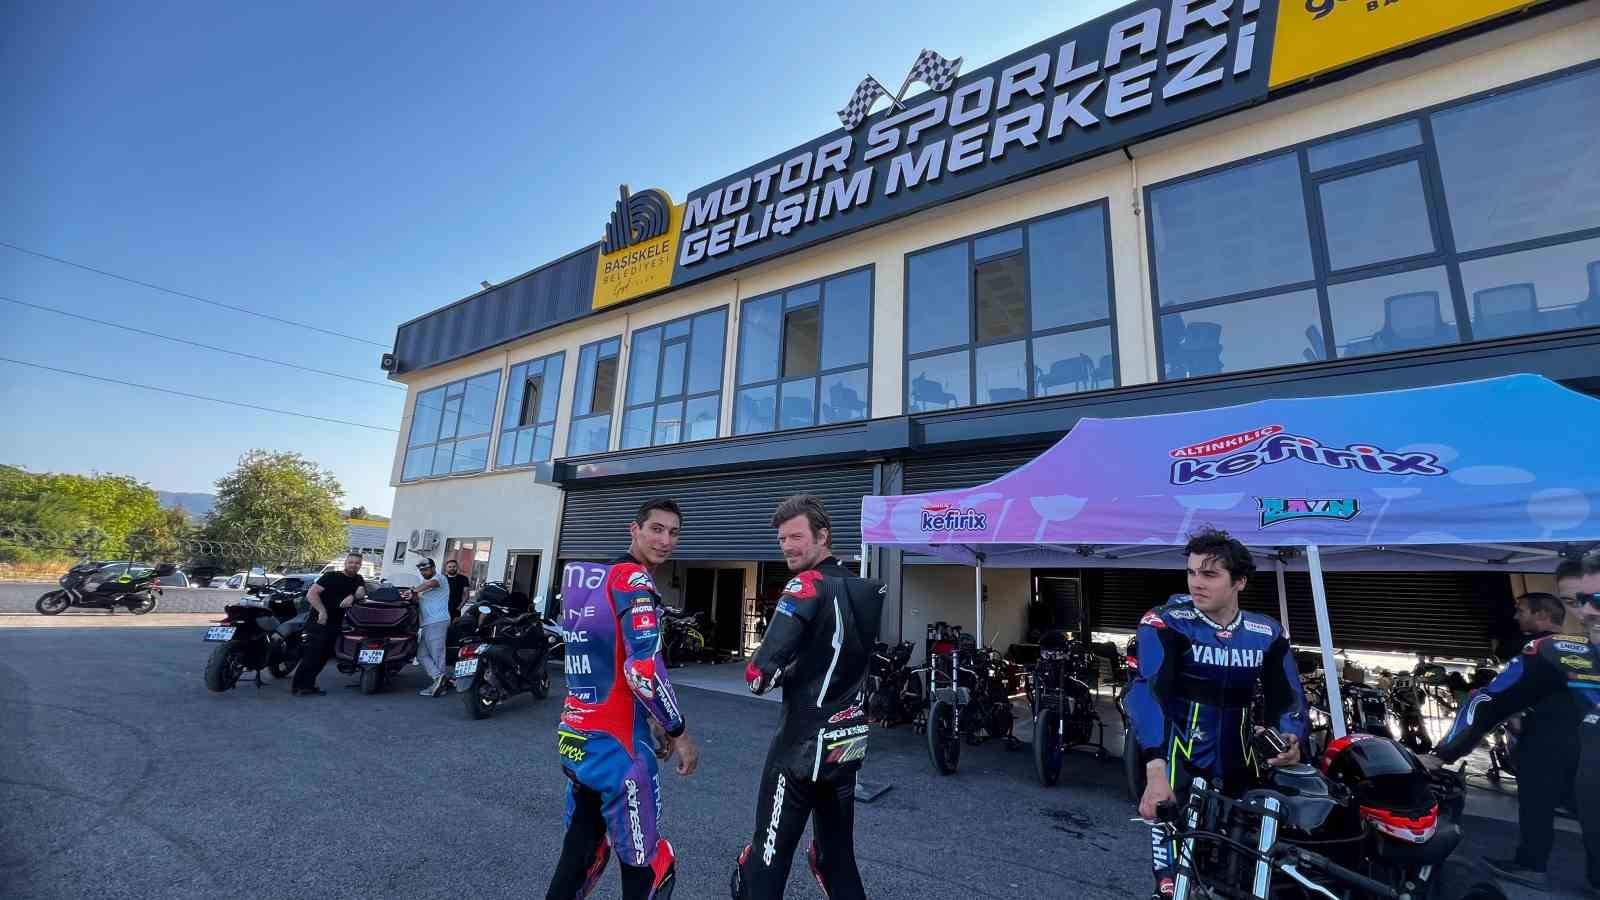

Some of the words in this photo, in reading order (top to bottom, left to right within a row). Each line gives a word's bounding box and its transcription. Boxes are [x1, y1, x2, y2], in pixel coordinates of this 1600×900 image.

[680, 166, 874, 266] GELİŞİM
[885, 22, 1257, 196] MERKEZİ
[683, 136, 852, 231] MOTOR
[1170, 433, 1448, 485] kefirix
[921, 508, 987, 531] kefirix
[1192, 645, 1264, 668] YAMAHA
